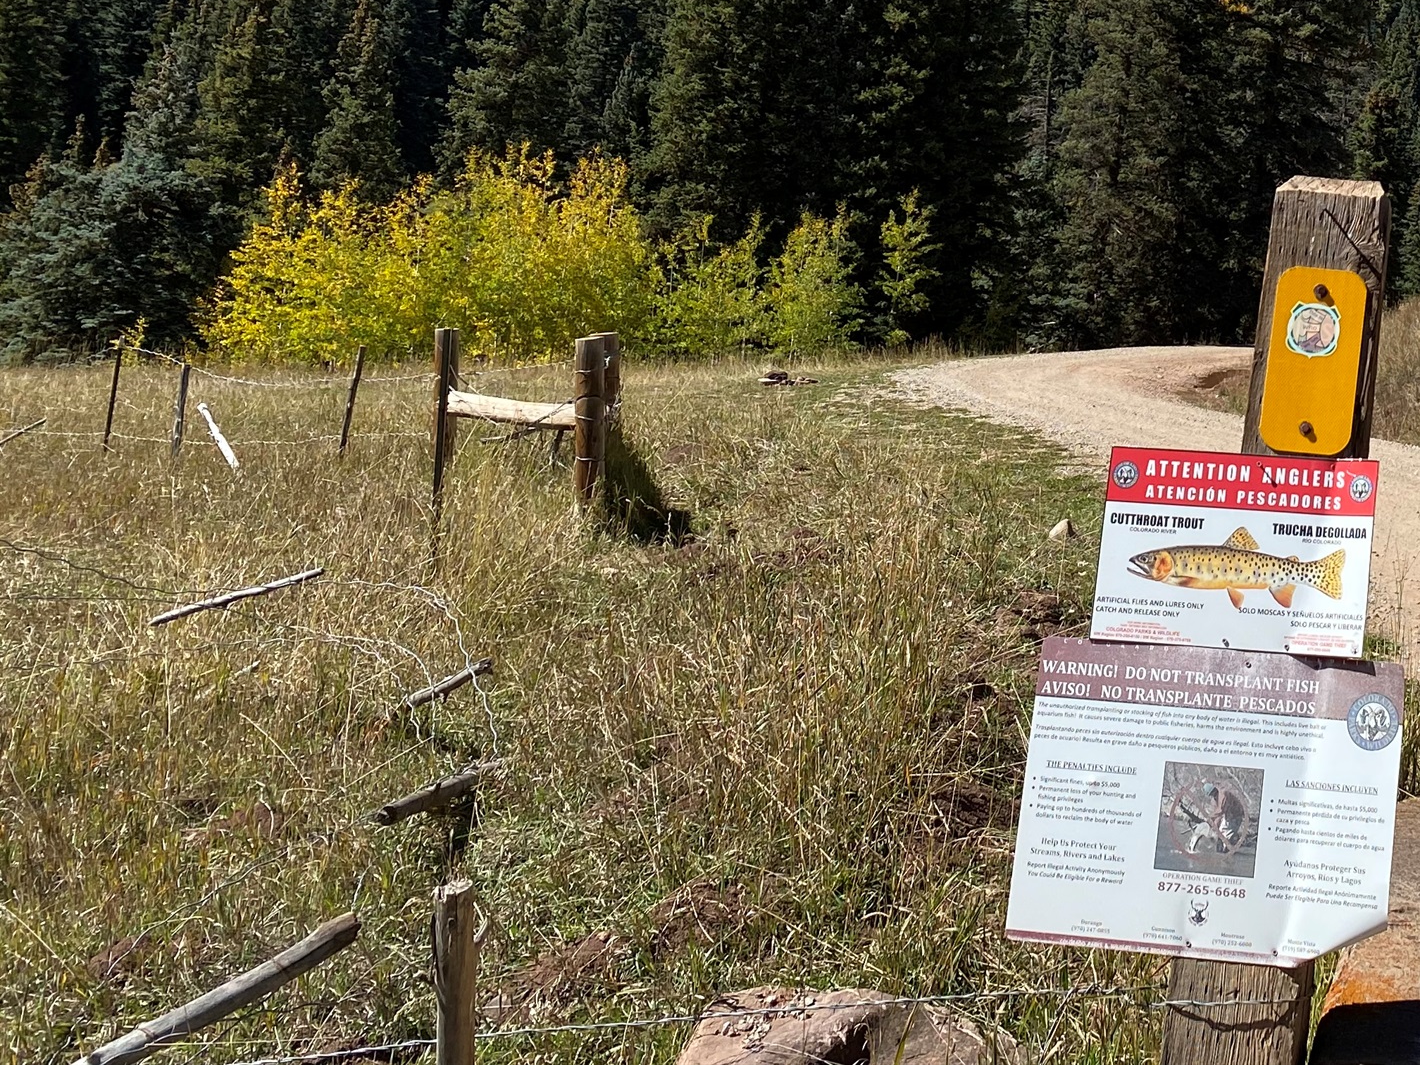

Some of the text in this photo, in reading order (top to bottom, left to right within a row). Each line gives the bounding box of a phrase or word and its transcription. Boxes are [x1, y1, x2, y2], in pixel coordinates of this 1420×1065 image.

[1146, 460, 1251, 482] ATTENTION
[1263, 467, 1345, 488] ANGLERS
[1146, 483, 1341, 509] ATENCIÓN PESCADORES
[1110, 513, 1204, 529] CUTTHROAT TROUT
[1272, 524, 1367, 539] TRUCHA DEGOLLADA
[1097, 596, 1130, 604] ARTIFICIAL
[1292, 610, 1324, 618] SEÑUELOS
[1042, 660, 1320, 694] WARNING! DO NOT TRANSPLANT FISH
[1041, 681, 1316, 714] AVISO! NO TRANSPLANTE PESCADOS
[1047, 760, 1137, 774] THE PENALTIES INCLUDE
[1041, 838, 1059, 847] Help
[1070, 840, 1097, 849] Protect
[1030, 847, 1125, 862] Streams, Rivers and Lakes
[1065, 865, 1086, 873] Activity
[1087, 867, 1125, 876] Anonymously
[1162, 872, 1201, 881] OPERATION
[1158, 882, 1246, 898] 877-265-6648
